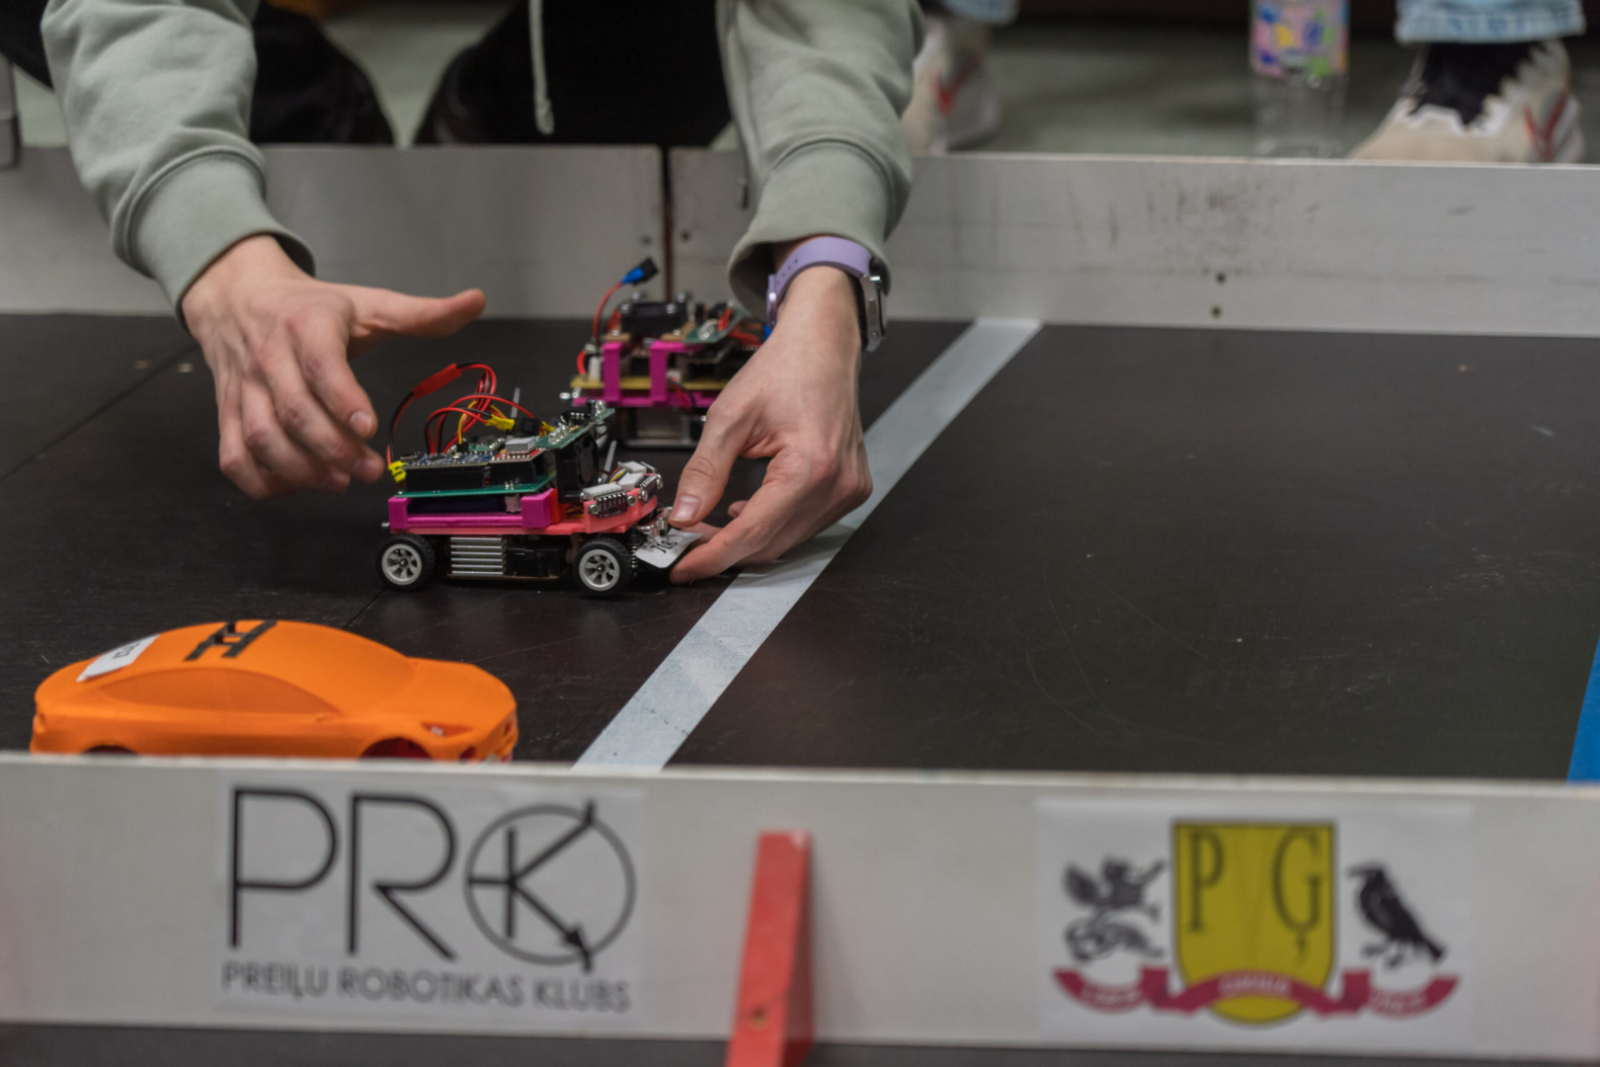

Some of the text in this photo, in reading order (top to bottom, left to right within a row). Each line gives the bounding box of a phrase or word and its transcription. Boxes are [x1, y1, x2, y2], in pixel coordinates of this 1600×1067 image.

[1186, 830, 1226, 934] P
[336, 966, 525, 1008] ROBOTIKAS
[532, 976, 632, 1014] KLUBS
